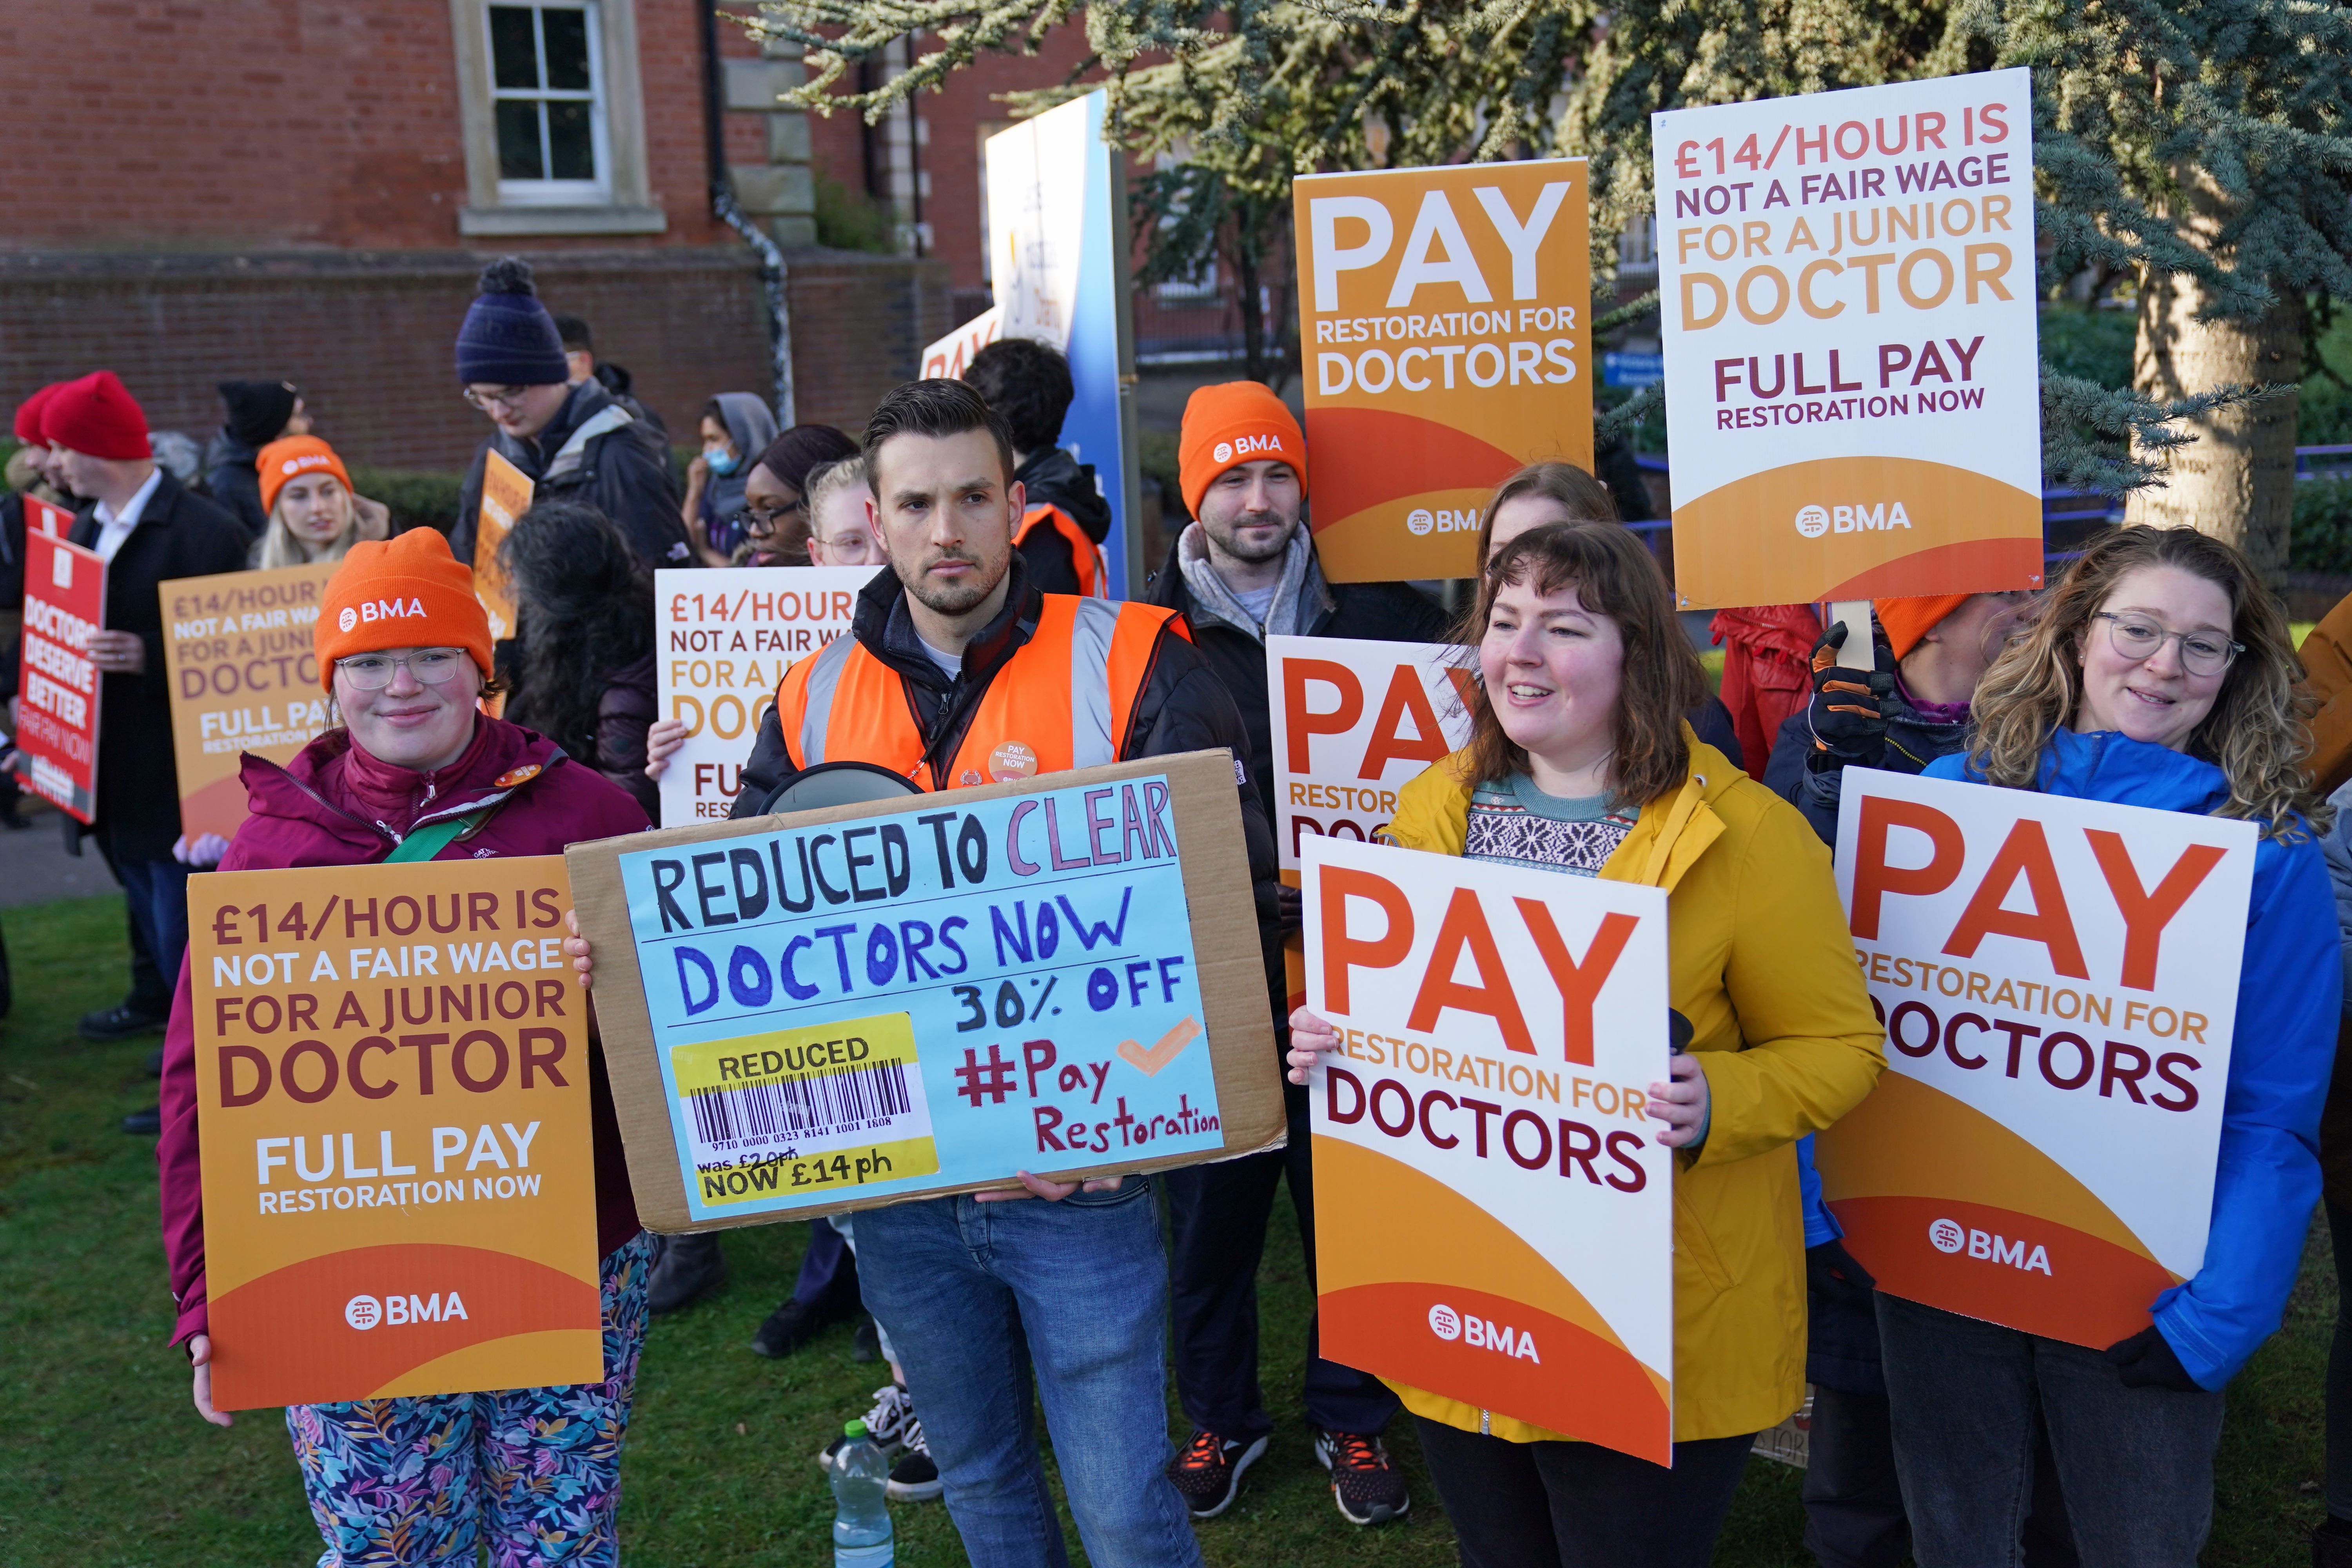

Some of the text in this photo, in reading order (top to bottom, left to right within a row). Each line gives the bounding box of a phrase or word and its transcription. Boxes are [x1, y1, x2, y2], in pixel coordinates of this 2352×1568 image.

[1674, 103, 2009, 179] £14/HOUR IS
[1675, 153, 2011, 218] NOT A FAIR WAGE
[1310, 181, 1572, 312] PAY
[1678, 194, 2013, 264] FOR A JUNIOR
[1680, 242, 2014, 332] DOCTOR
[1316, 306, 1575, 343] RESTORATION FOR
[1318, 339, 1576, 396] DOCTORS
[1715, 336, 1985, 403] FULL PAY
[1717, 388, 1985, 430] RESTORATION NOW
[1234, 434, 1283, 454] BMA
[1833, 501, 1911, 533] BMA
[173, 581, 317, 618] £14/HOUR
[173, 605, 321, 640] NOT A FAIR WA
[361, 598, 427, 623] BMA
[670, 589, 852, 622] £14/HOUR
[24, 632, 95, 695] DESERVE
[177, 629, 314, 662] FOR A JUNI
[671, 630, 722, 652] NOT
[730, 630, 748, 652] A
[756, 629, 811, 652] FAIR
[180, 652, 321, 699] DOCTO
[671, 660, 735, 688] FOR
[745, 660, 766, 688] A
[27, 670, 87, 730] BETTER
[200, 706, 283, 739] FULL
[202, 729, 307, 754] RESTORATION
[995, 751, 1035, 762] RESTORATION
[1003, 758, 1025, 768] NOW
[1007, 745, 1025, 755] PAY
[694, 764, 742, 797] FU
[1289, 782, 1398, 815] RESTOR
[651, 781, 1177, 933] REDUCED TO CLEAR
[1849, 794, 2229, 992] PAY
[212, 888, 561, 945] £14/HOUR IS
[213, 938, 563, 987] NOT A FAIR WAGE
[673, 886, 1133, 1017] DOCTORS NOW
[1318, 864, 1641, 1067] PAY
[216, 979, 566, 1036] FOR A JUNIOR
[951, 955, 1184, 1033] 30% OFF
[2124, 1000, 2209, 1045] FOR
[218, 1027, 570, 1108] DOCTOR
[718, 1037, 869, 1081] REDUCED
[1326, 1025, 1647, 1122] RESTORATION FOR
[712, 1116, 891, 1151] 9710 0000 0323 8141 1001 1808
[1032, 1094, 1220, 1154] Restoration
[1326, 1065, 1647, 1194] DOCTORS
[256, 1121, 541, 1185] FULL PAY
[697, 1160, 733, 1174] was
[259, 1174, 542, 1214] RESTORATION NOW
[704, 1167, 779, 1198] NOW
[1968, 1229, 2052, 1276] BMA
[386, 1292, 468, 1325] BMA
[1465, 1314, 1540, 1364] BMA
